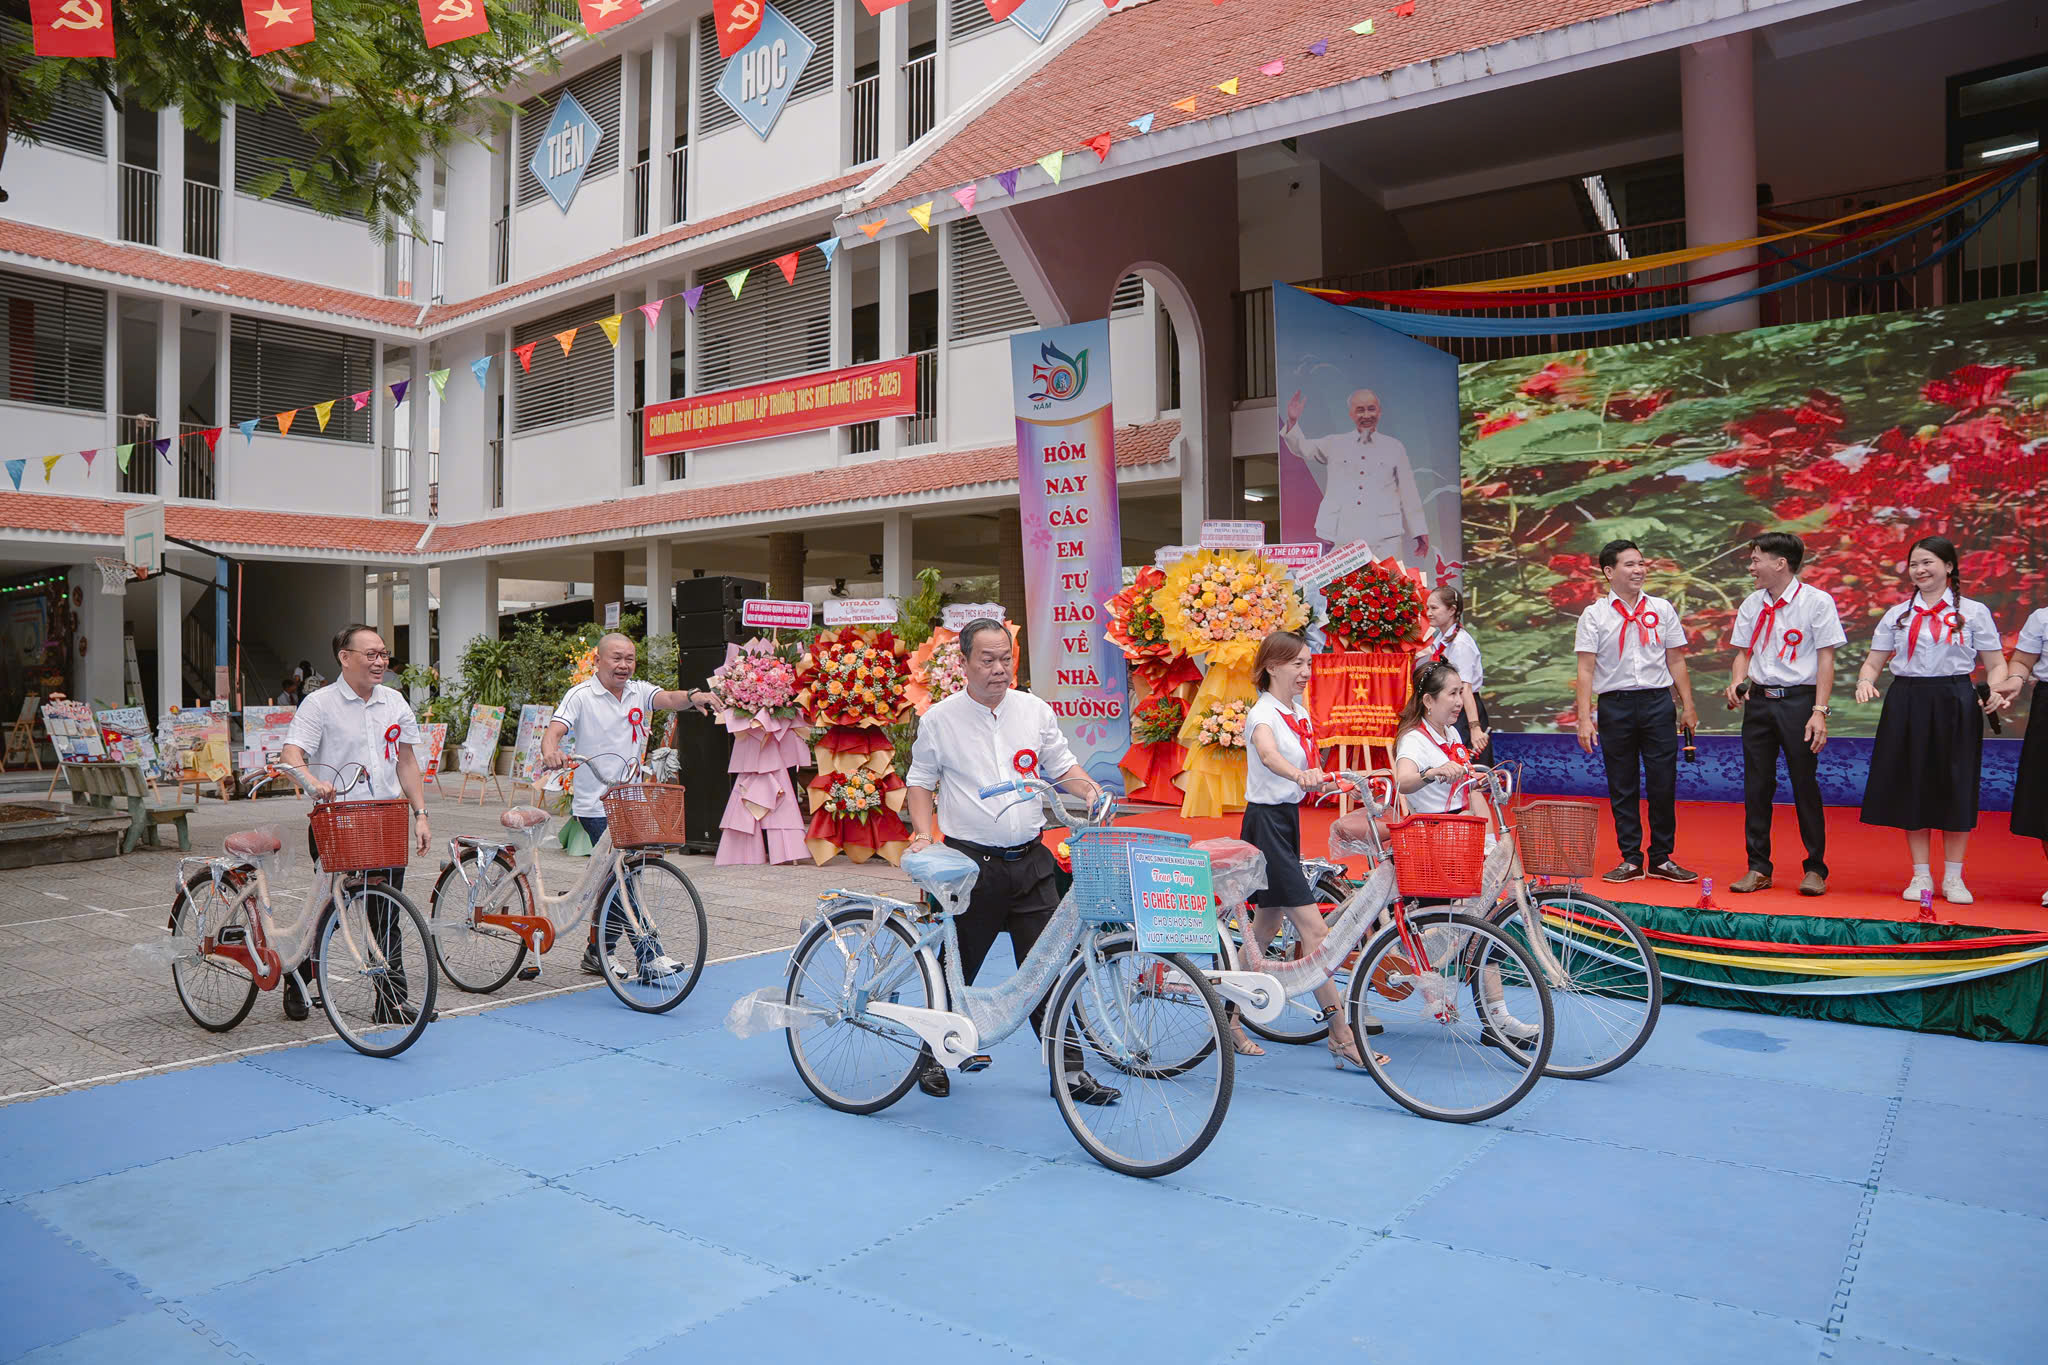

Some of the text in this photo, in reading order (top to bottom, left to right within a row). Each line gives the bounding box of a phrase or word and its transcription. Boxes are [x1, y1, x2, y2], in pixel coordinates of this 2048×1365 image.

[741, 38, 787, 106] HỌC
[546, 120, 585, 179] TIÊN
[650, 411, 664, 437] CHÀO
[666, 409, 683, 434] MỪNG
[684, 403, 692, 431] KỶ
[692, 404, 708, 433] NIỆM
[709, 406, 717, 426] 50
[718, 400, 732, 425] NĂM
[734, 396, 755, 423] THÀNH
[756, 392, 768, 422] LẬP
[769, 387, 796, 416] TRƯỜNG
[796, 387, 814, 412] THCS
[815, 384, 829, 408] KIM
[830, 376, 850, 406] ĐỒNG
[852, 376, 872, 404] (1975
[878, 372, 901, 397] 2025)
[1043, 441, 1087, 464] HÔM
[1046, 475, 1088, 495] NAY
[1049, 505, 1089, 527] CÁC
[1056, 540, 1085, 558] EM
[1061, 570, 1090, 593] TỰ
[965, 609, 976, 618] THCS
[978, 610, 986, 618] Kim
[1053, 602, 1096, 622] HÀO
[1063, 630, 1090, 654] VỀ
[1056, 665, 1100, 686] NHÀ
[1047, 698, 1121, 718] RƯỜNG
[1152, 869, 1194, 887] Trao Tặng
[1142, 888, 1207, 914] 5 CHIẾC XE ĐẠP
[1153, 917, 1202, 928] CHO 5 HỌC SINH
[1147, 932, 1164, 944] VƯỢT
